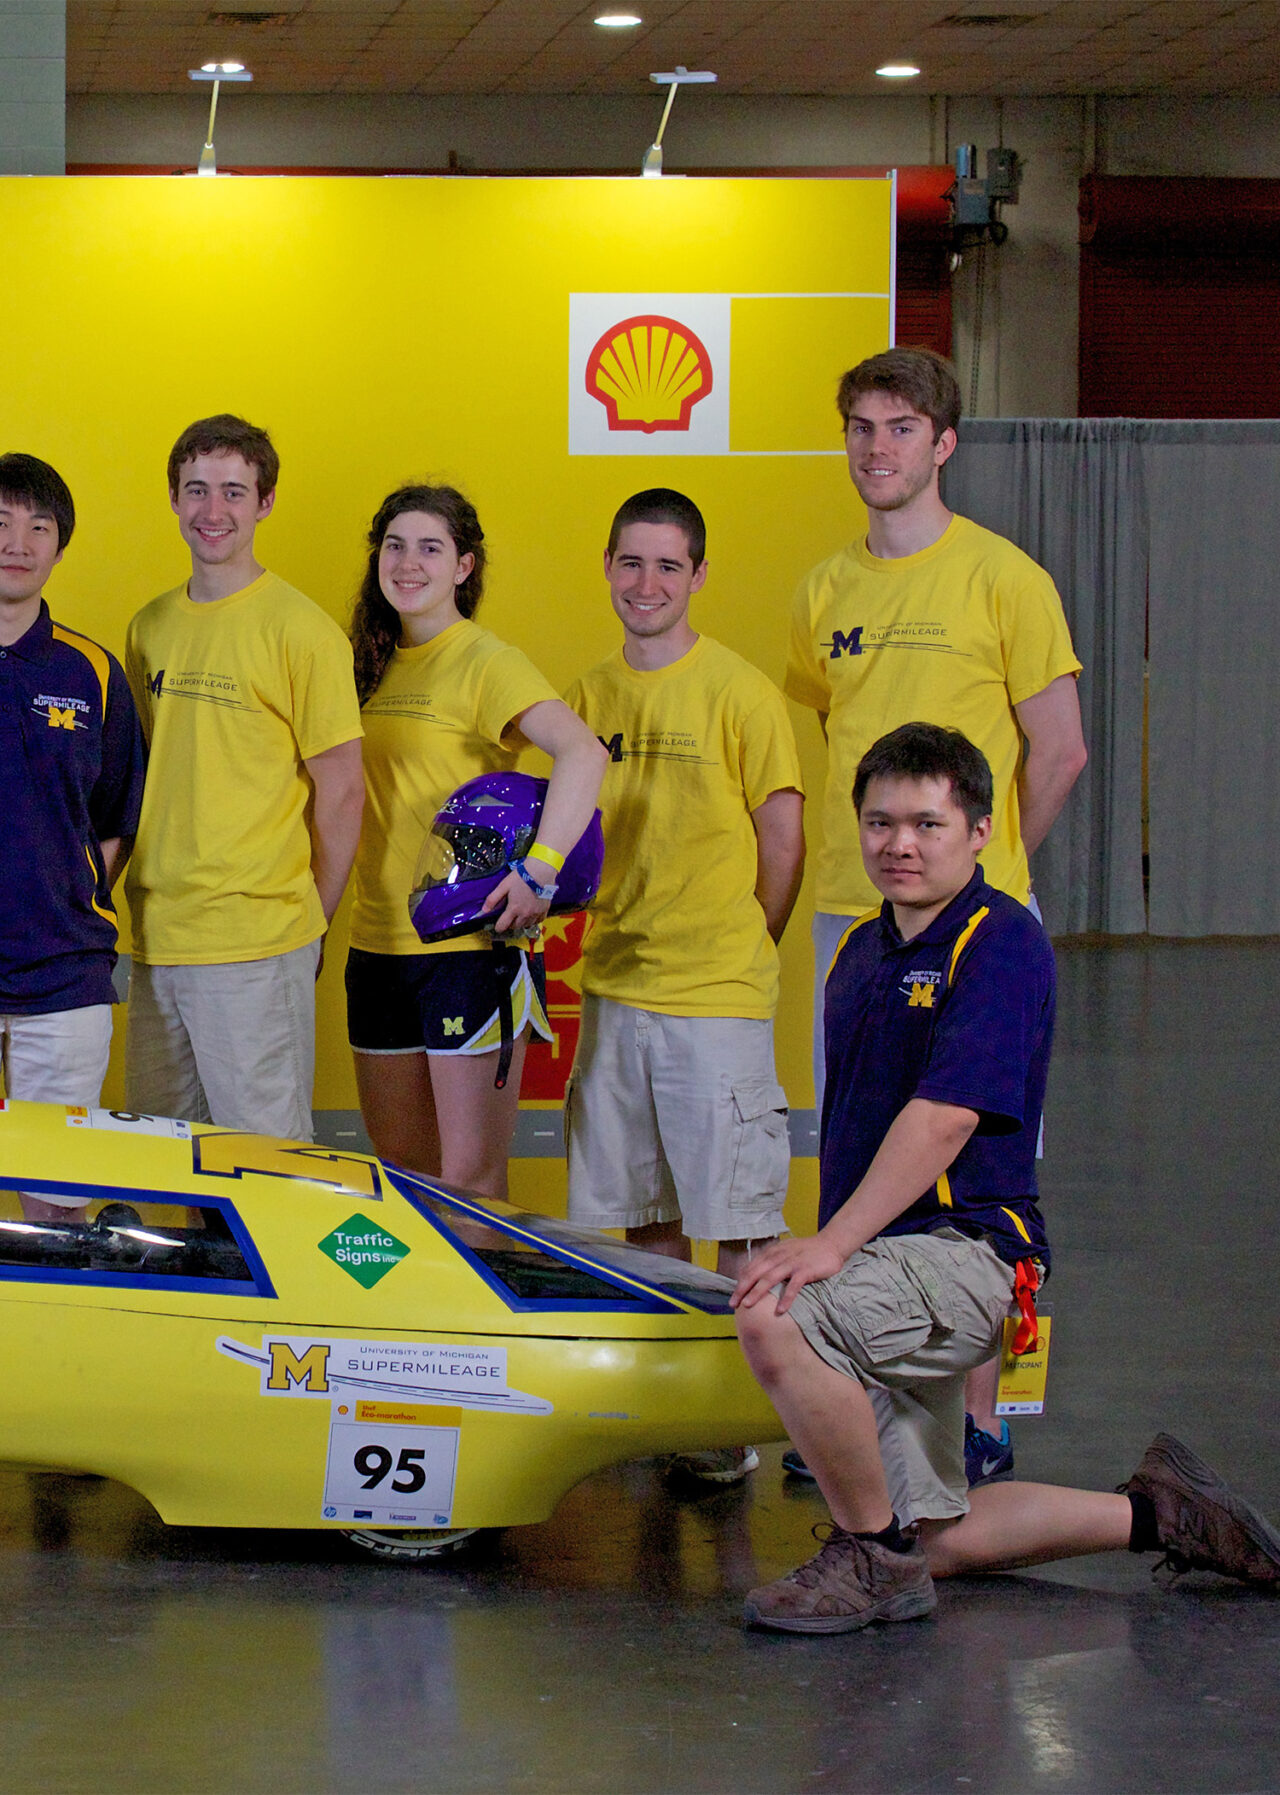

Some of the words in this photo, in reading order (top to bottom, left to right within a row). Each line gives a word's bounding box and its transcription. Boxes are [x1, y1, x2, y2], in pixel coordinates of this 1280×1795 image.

[829, 626, 864, 659] M
[33, 698, 91, 714] SUPERMILEAGE
[47, 706, 77, 731] M
[907, 982, 936, 1009] M
[442, 1016, 466, 1036] M
[333, 1232, 393, 1247] Traffic
[335, 1247, 381, 1266] Signs
[360, 1346, 421, 1357] UNIVERSITY
[422, 1350, 437, 1358] OF
[439, 1350, 489, 1360] MICHIGAN
[267, 1342, 331, 1392] M
[347, 1359, 501, 1378] SUPERMILEAGE
[361, 1411, 417, 1421] Eco-marathon
[353, 1445, 426, 1494] 95
